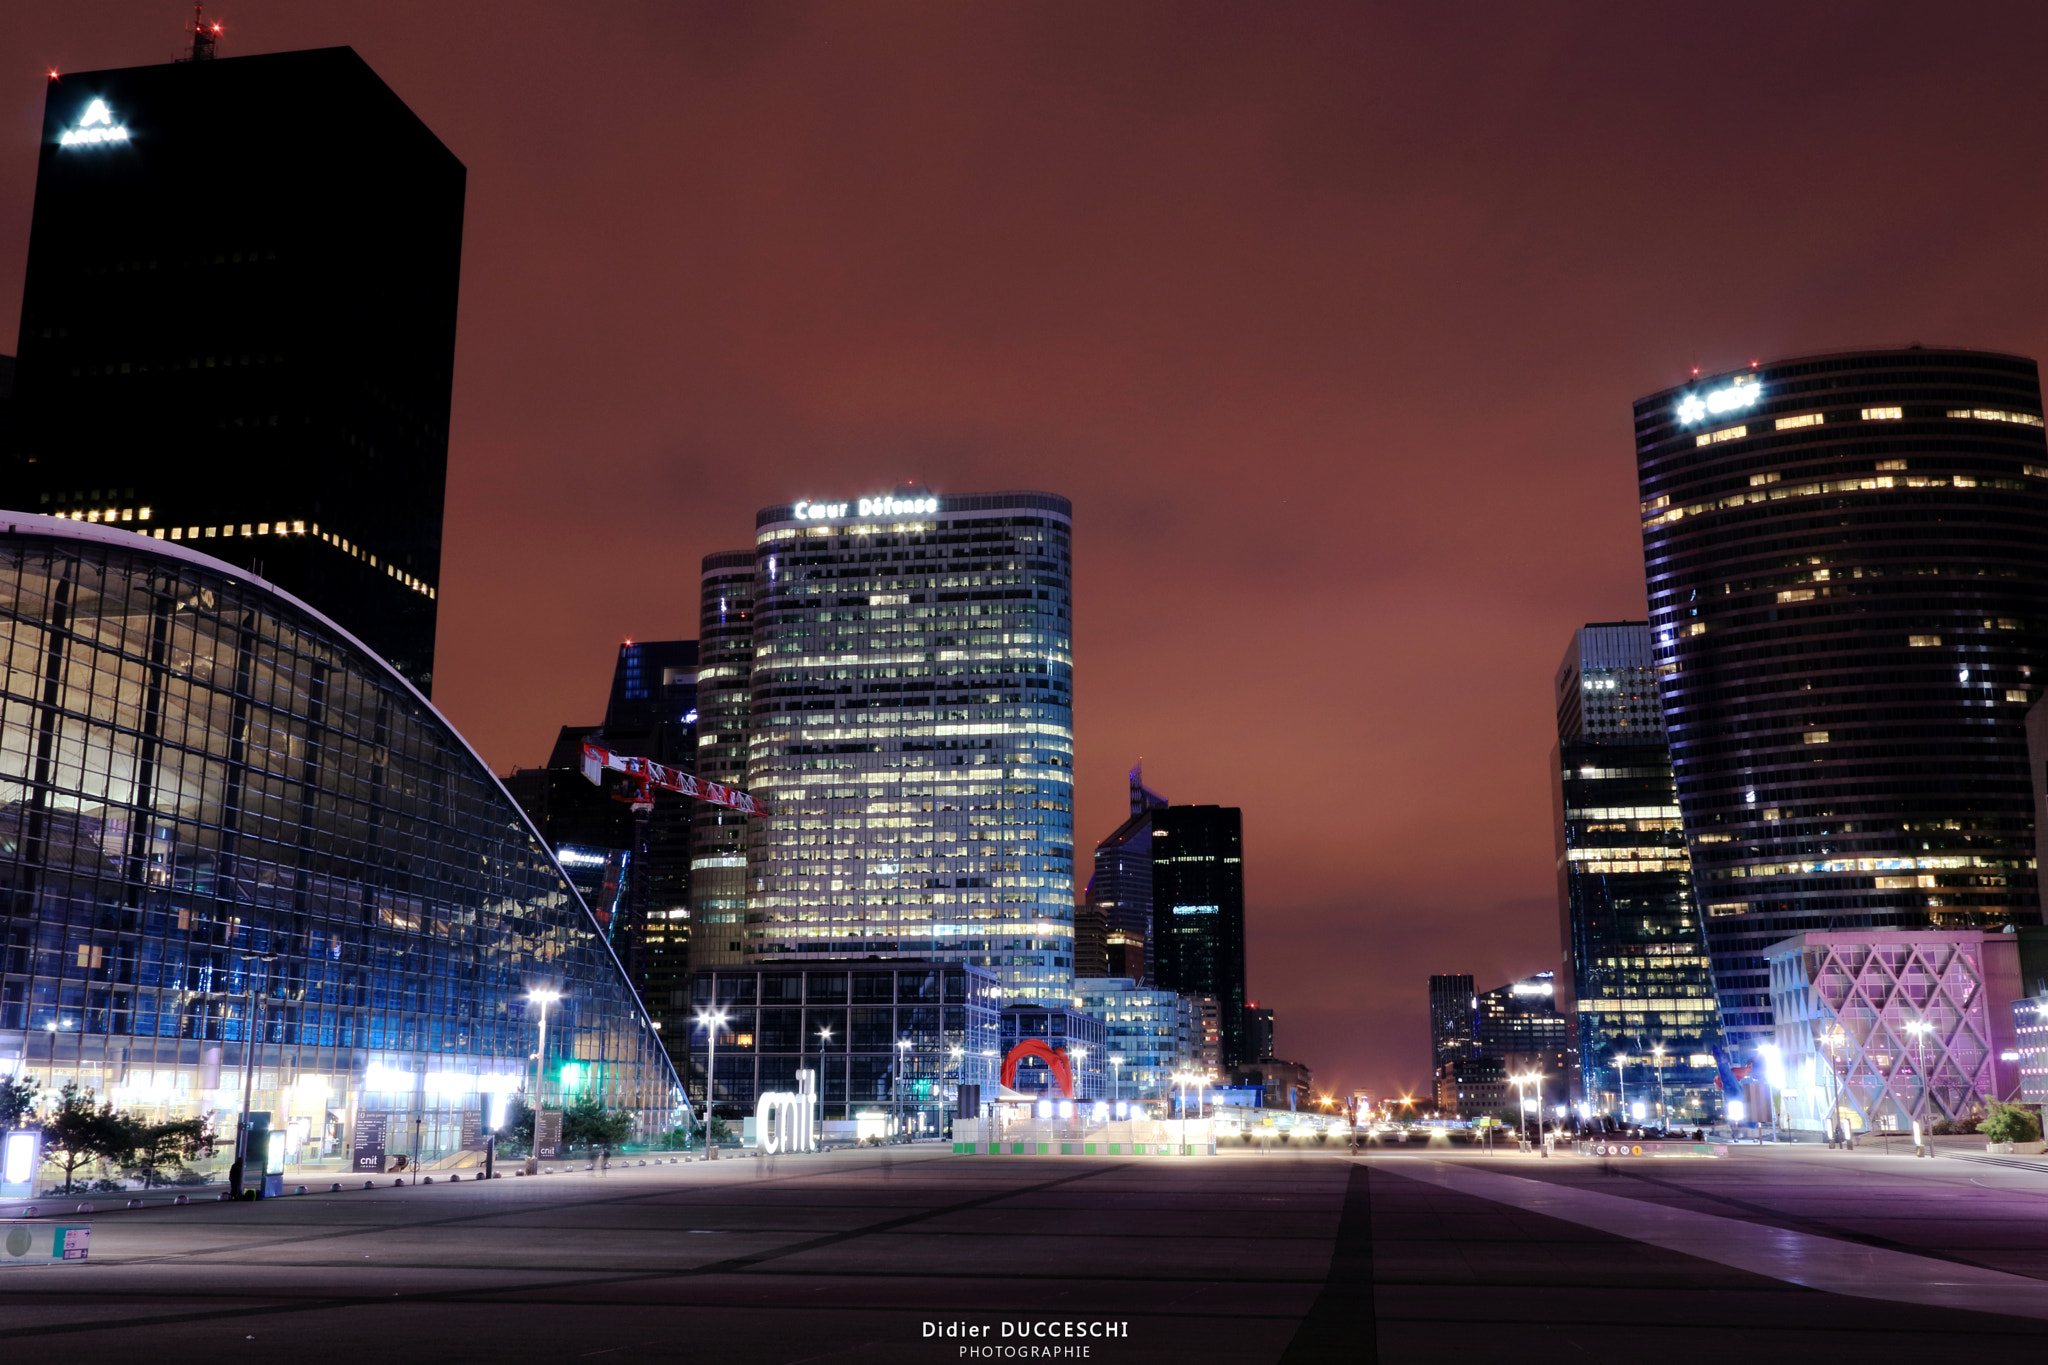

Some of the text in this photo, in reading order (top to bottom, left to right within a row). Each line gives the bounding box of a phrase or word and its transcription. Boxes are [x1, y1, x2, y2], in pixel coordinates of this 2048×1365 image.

[794, 496, 938, 520] Cœur Défense
[756, 1069, 817, 1154] cnit
[540, 1146, 555, 1155] cnit
[360, 1155, 378, 1165] cnit
